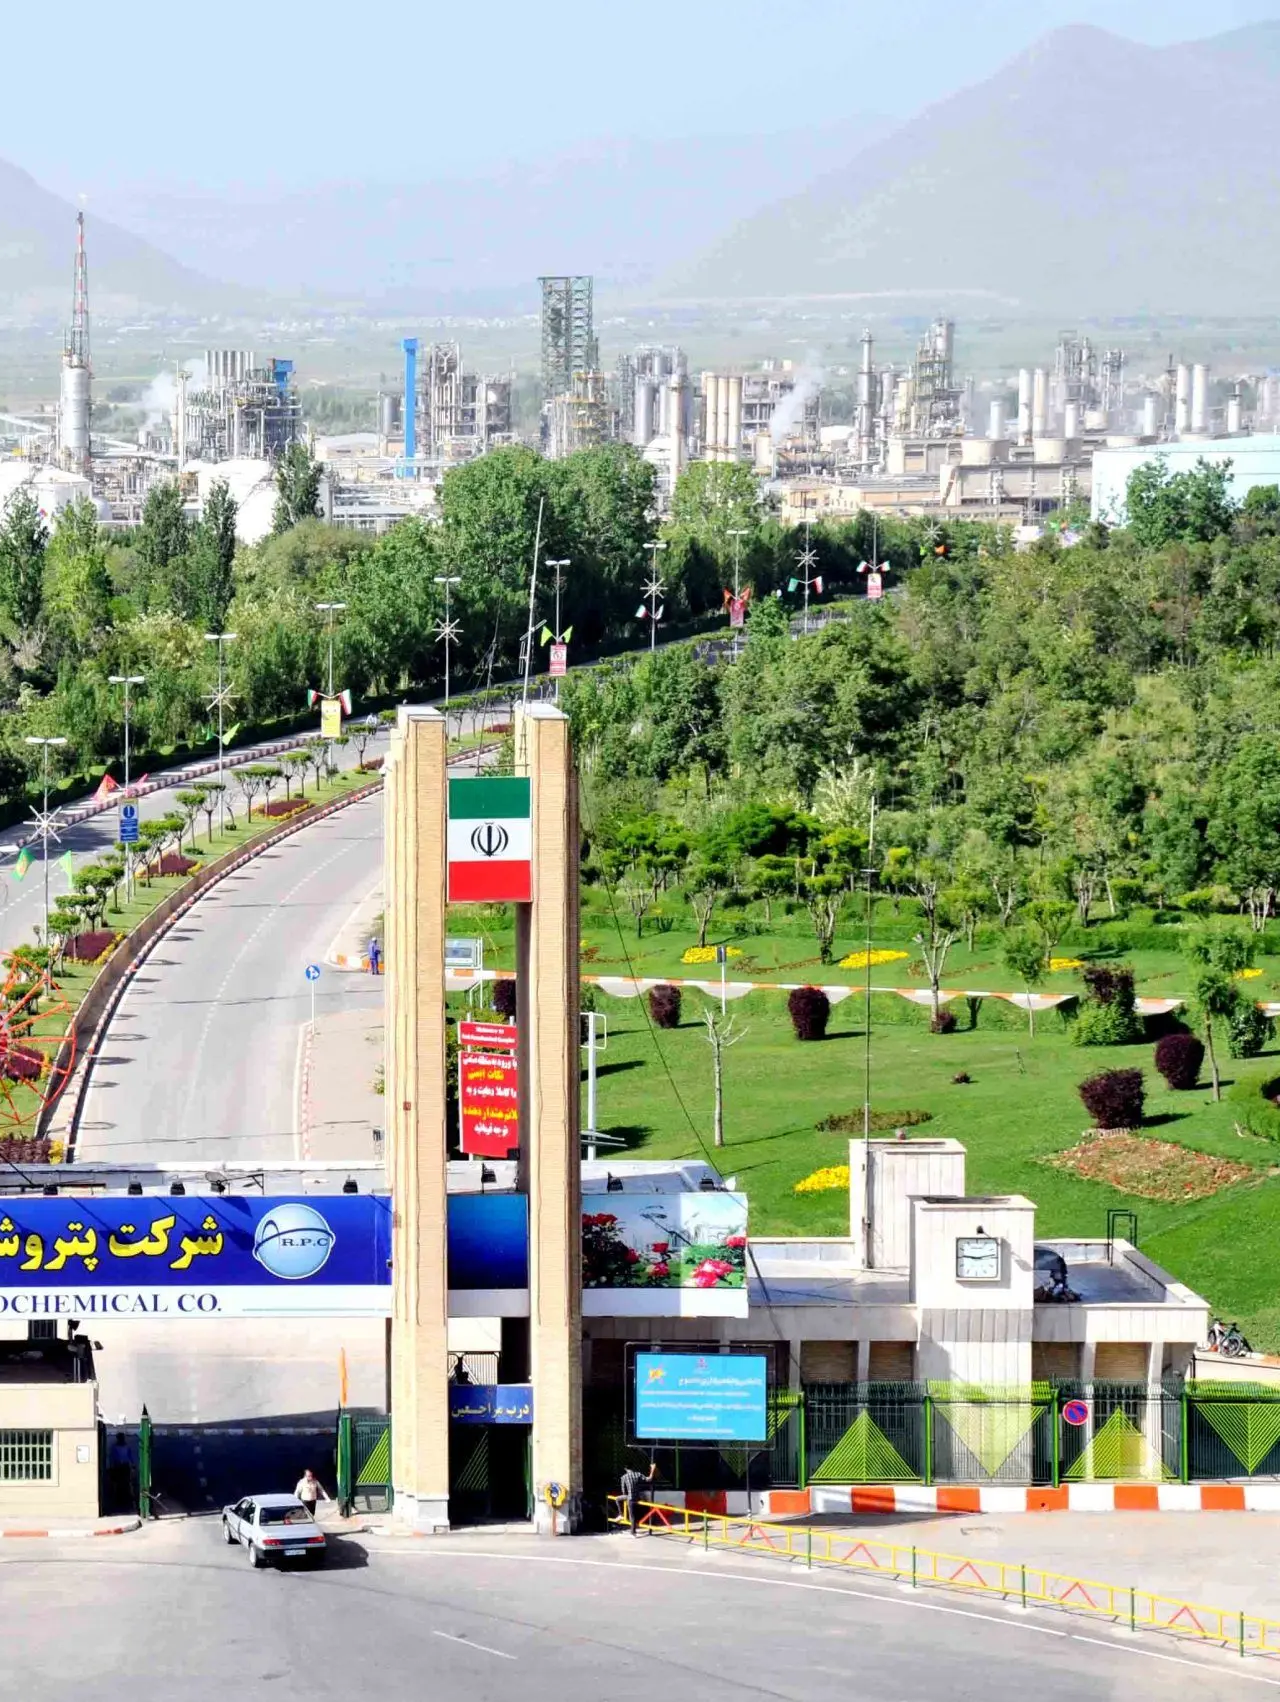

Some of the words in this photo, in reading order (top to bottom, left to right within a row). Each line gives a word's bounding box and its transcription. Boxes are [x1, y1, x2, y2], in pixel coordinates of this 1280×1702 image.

[108, 1214, 224, 1270] شرکت
[281, 1237, 329, 1247] R.P.C
[177, 1293, 223, 1313] CO.
